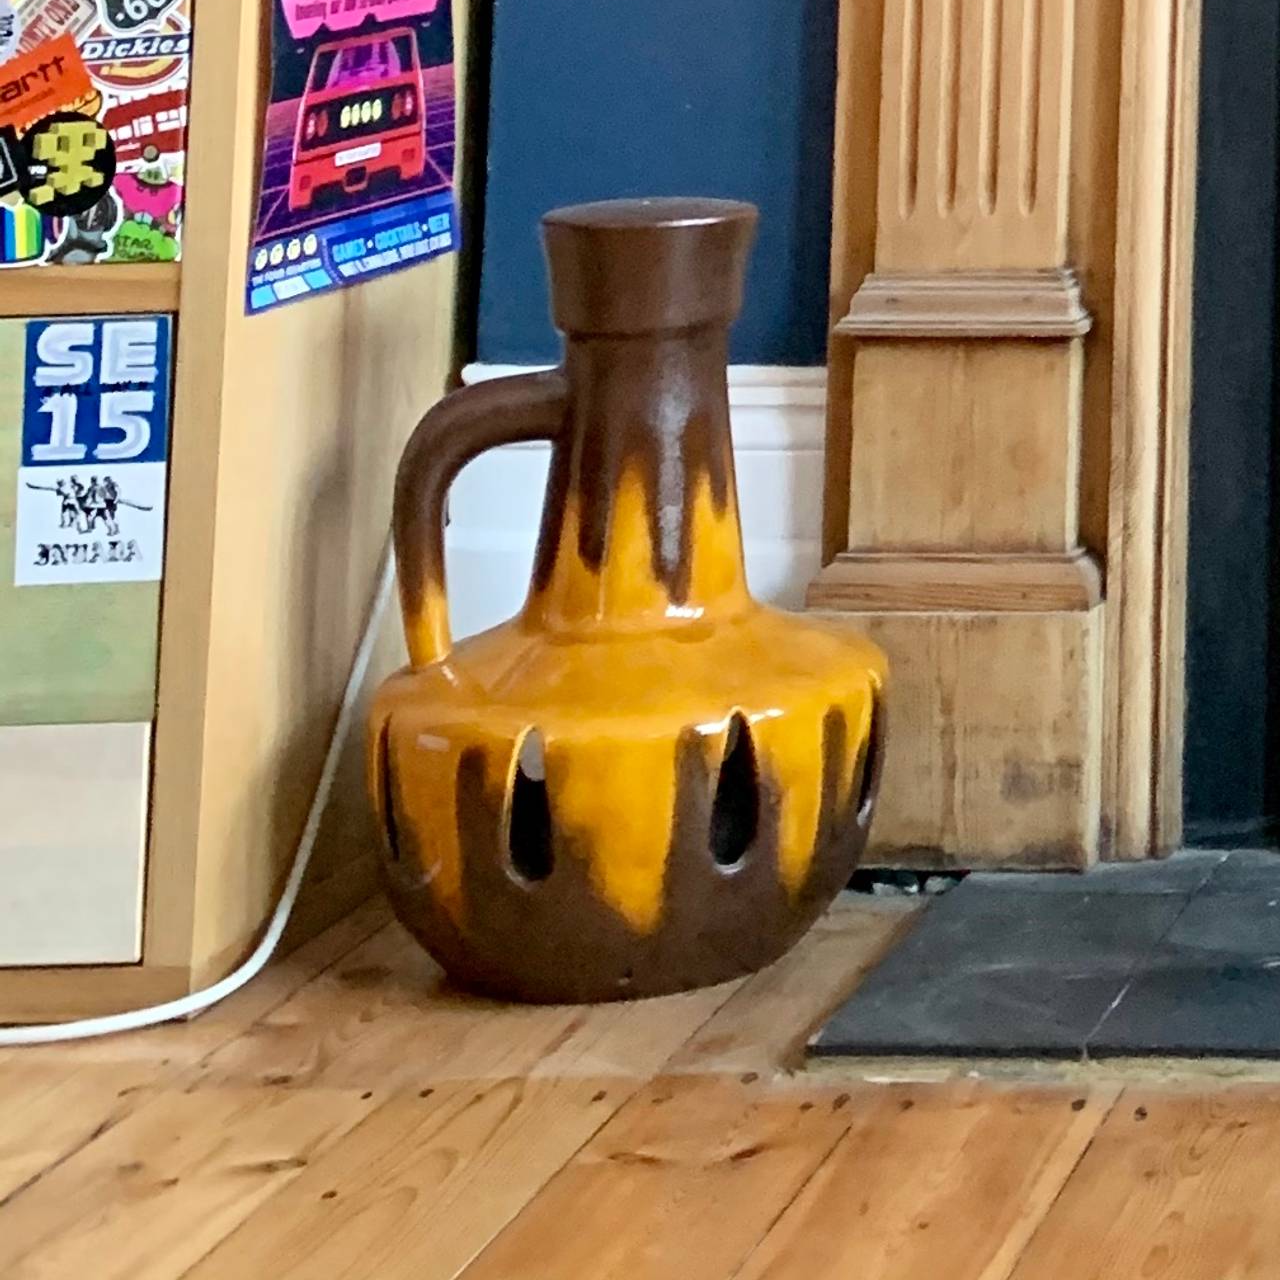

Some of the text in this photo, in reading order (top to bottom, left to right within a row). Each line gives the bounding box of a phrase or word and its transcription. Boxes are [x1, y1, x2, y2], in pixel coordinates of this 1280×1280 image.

[82, 36, 189, 58] Dickies
[33, 321, 159, 387] SE
[30, 390, 155, 461] 15
